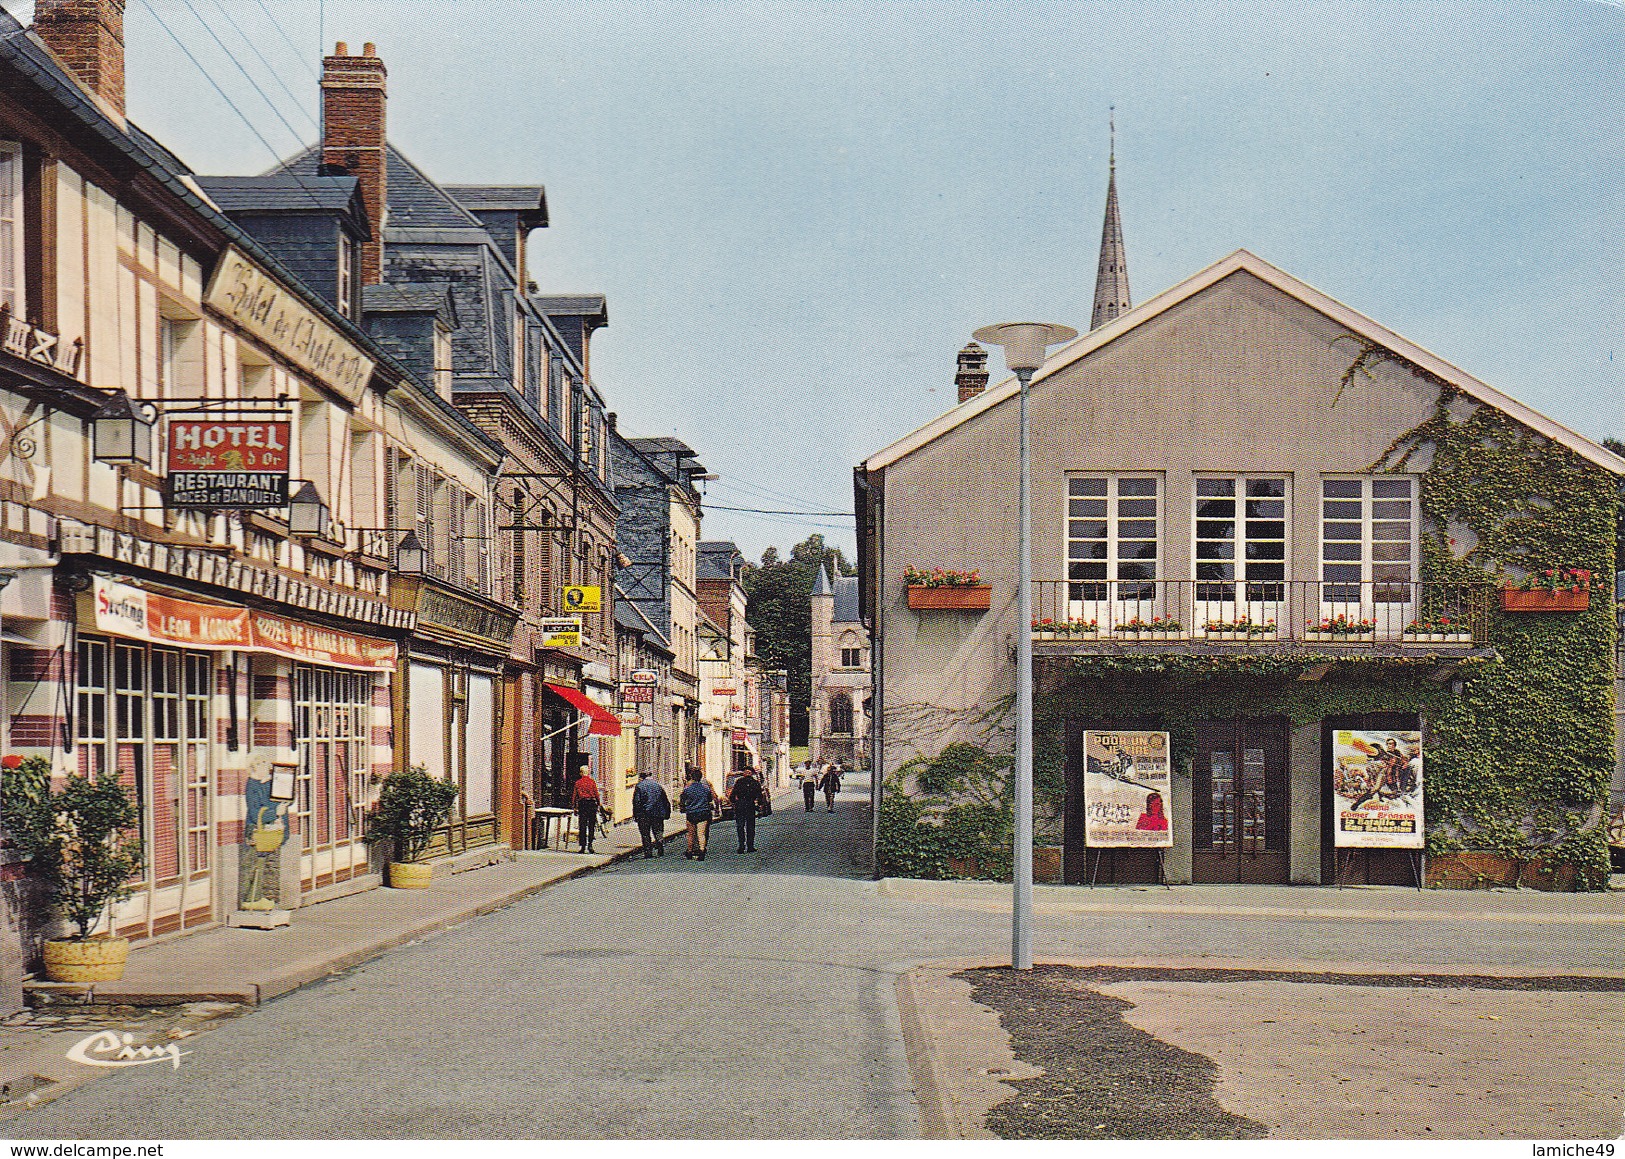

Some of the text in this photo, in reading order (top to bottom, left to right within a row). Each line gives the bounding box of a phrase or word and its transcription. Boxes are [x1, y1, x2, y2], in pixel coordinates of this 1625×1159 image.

[175, 425, 285, 451] HOTEL
[174, 474, 282, 491] RESTAURANT
[173, 490, 208, 503] NOCES
[222, 488, 281, 504] BANQUETS
[291, 625, 304, 647] DE
